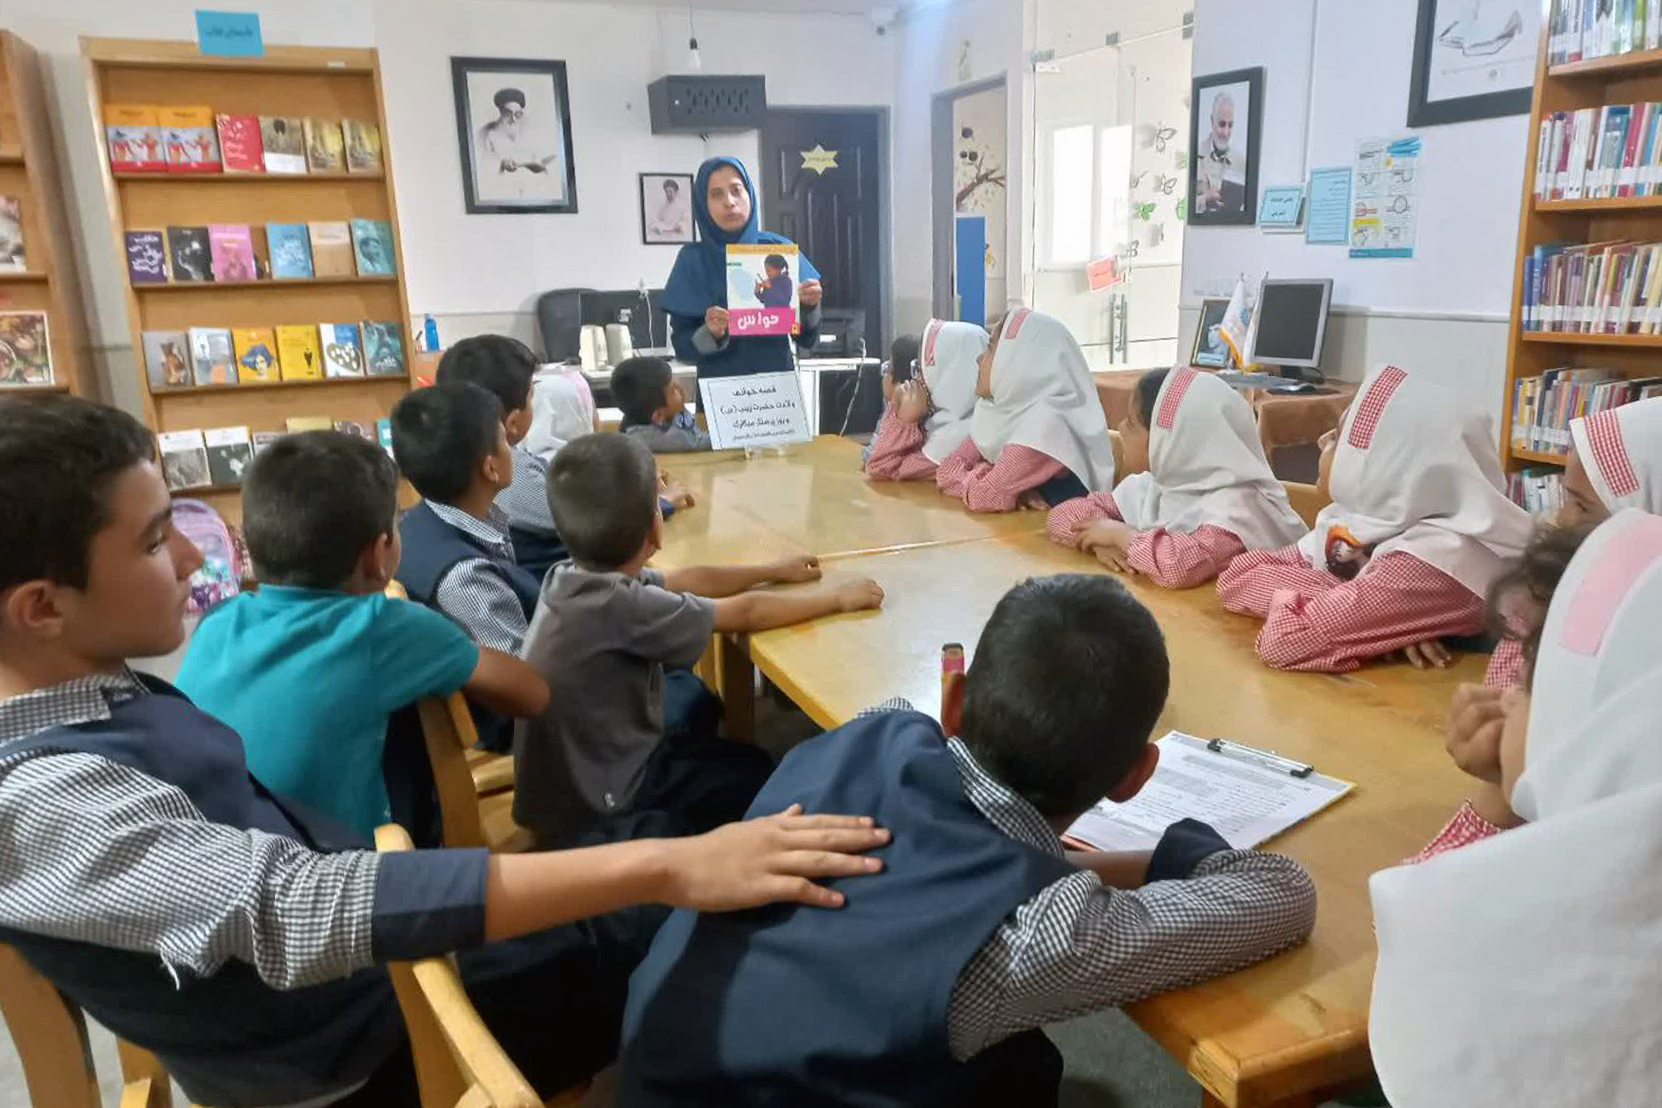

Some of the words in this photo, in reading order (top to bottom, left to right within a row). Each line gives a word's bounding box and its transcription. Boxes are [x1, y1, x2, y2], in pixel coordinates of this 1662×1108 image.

[737, 311, 779, 330] حواس
[733, 388, 758, 396] خوانی
[759, 385, 777, 393] قصه
[753, 403, 774, 411] حضرت
[776, 400, 795, 408] ولادت
